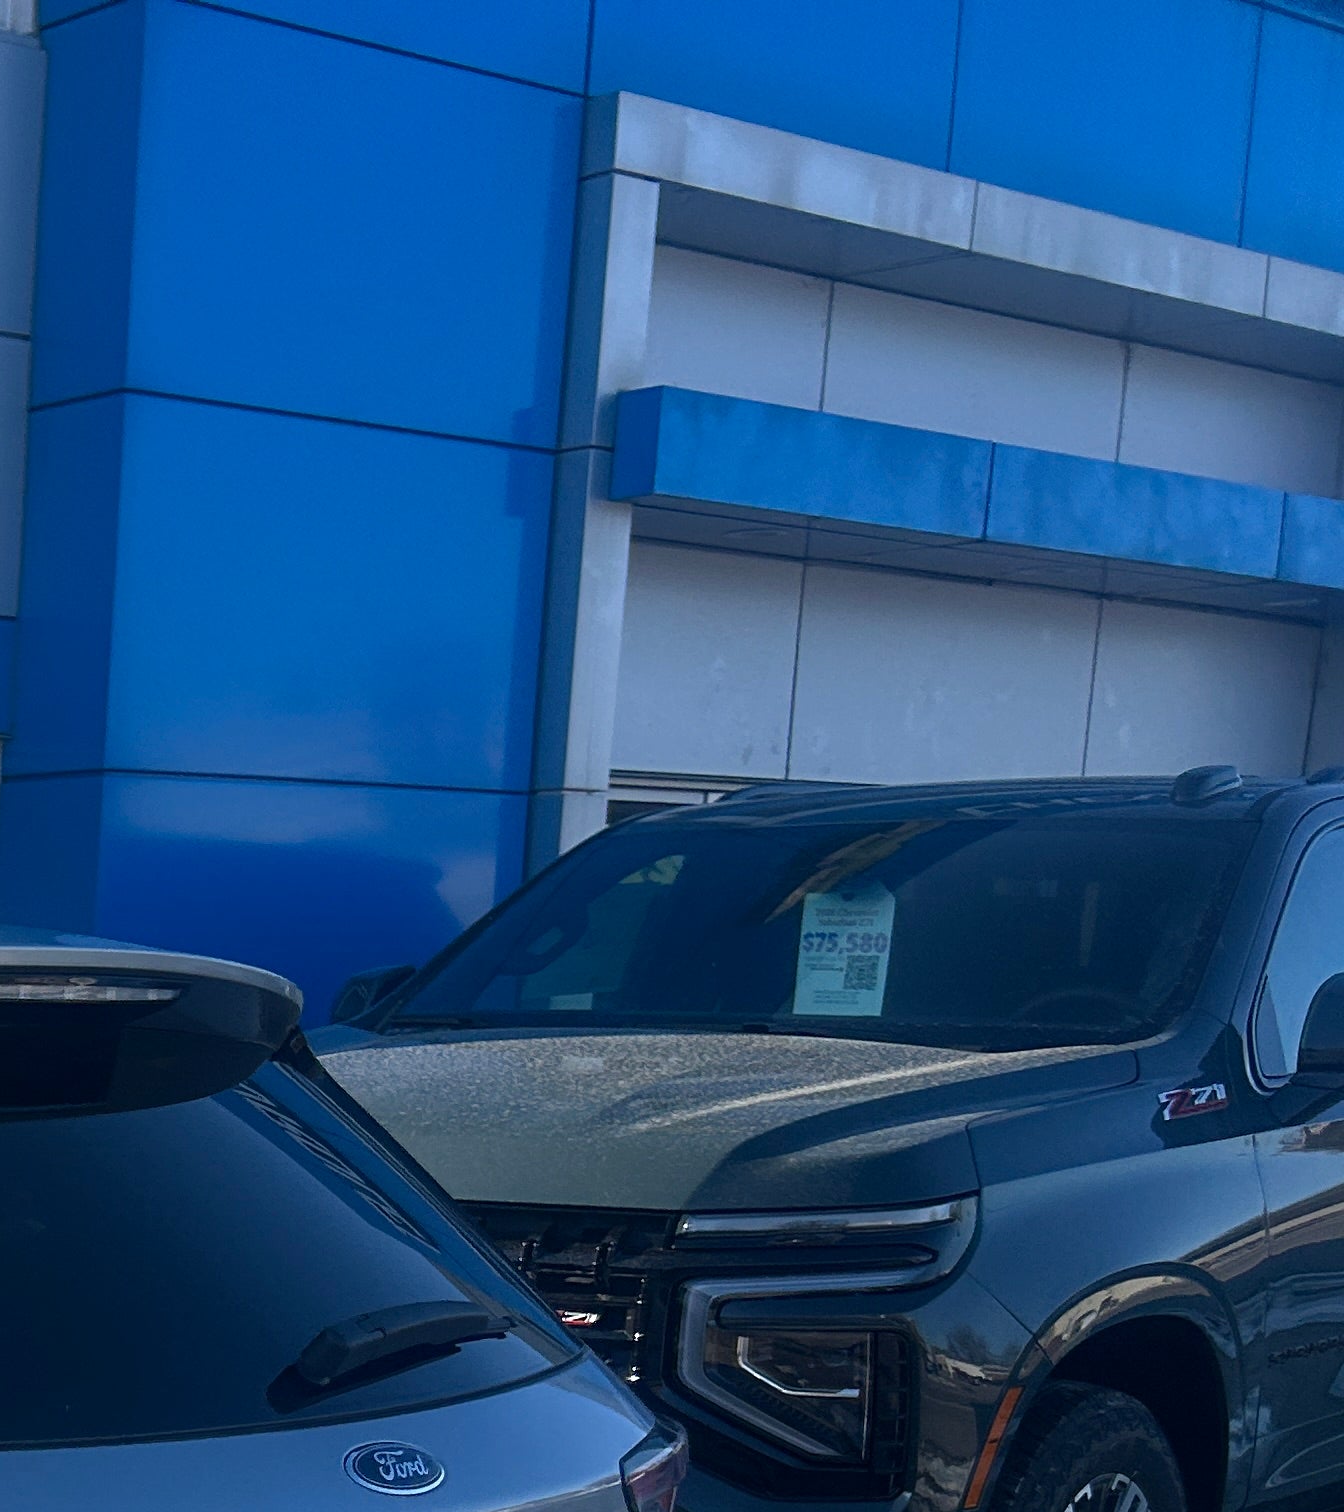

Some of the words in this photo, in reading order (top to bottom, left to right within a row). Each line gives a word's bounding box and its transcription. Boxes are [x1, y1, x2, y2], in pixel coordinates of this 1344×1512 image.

[802, 932, 888, 954] $75,580
[1158, 1083, 1228, 1121] Z71
[373, 1450, 429, 1481] Ford
